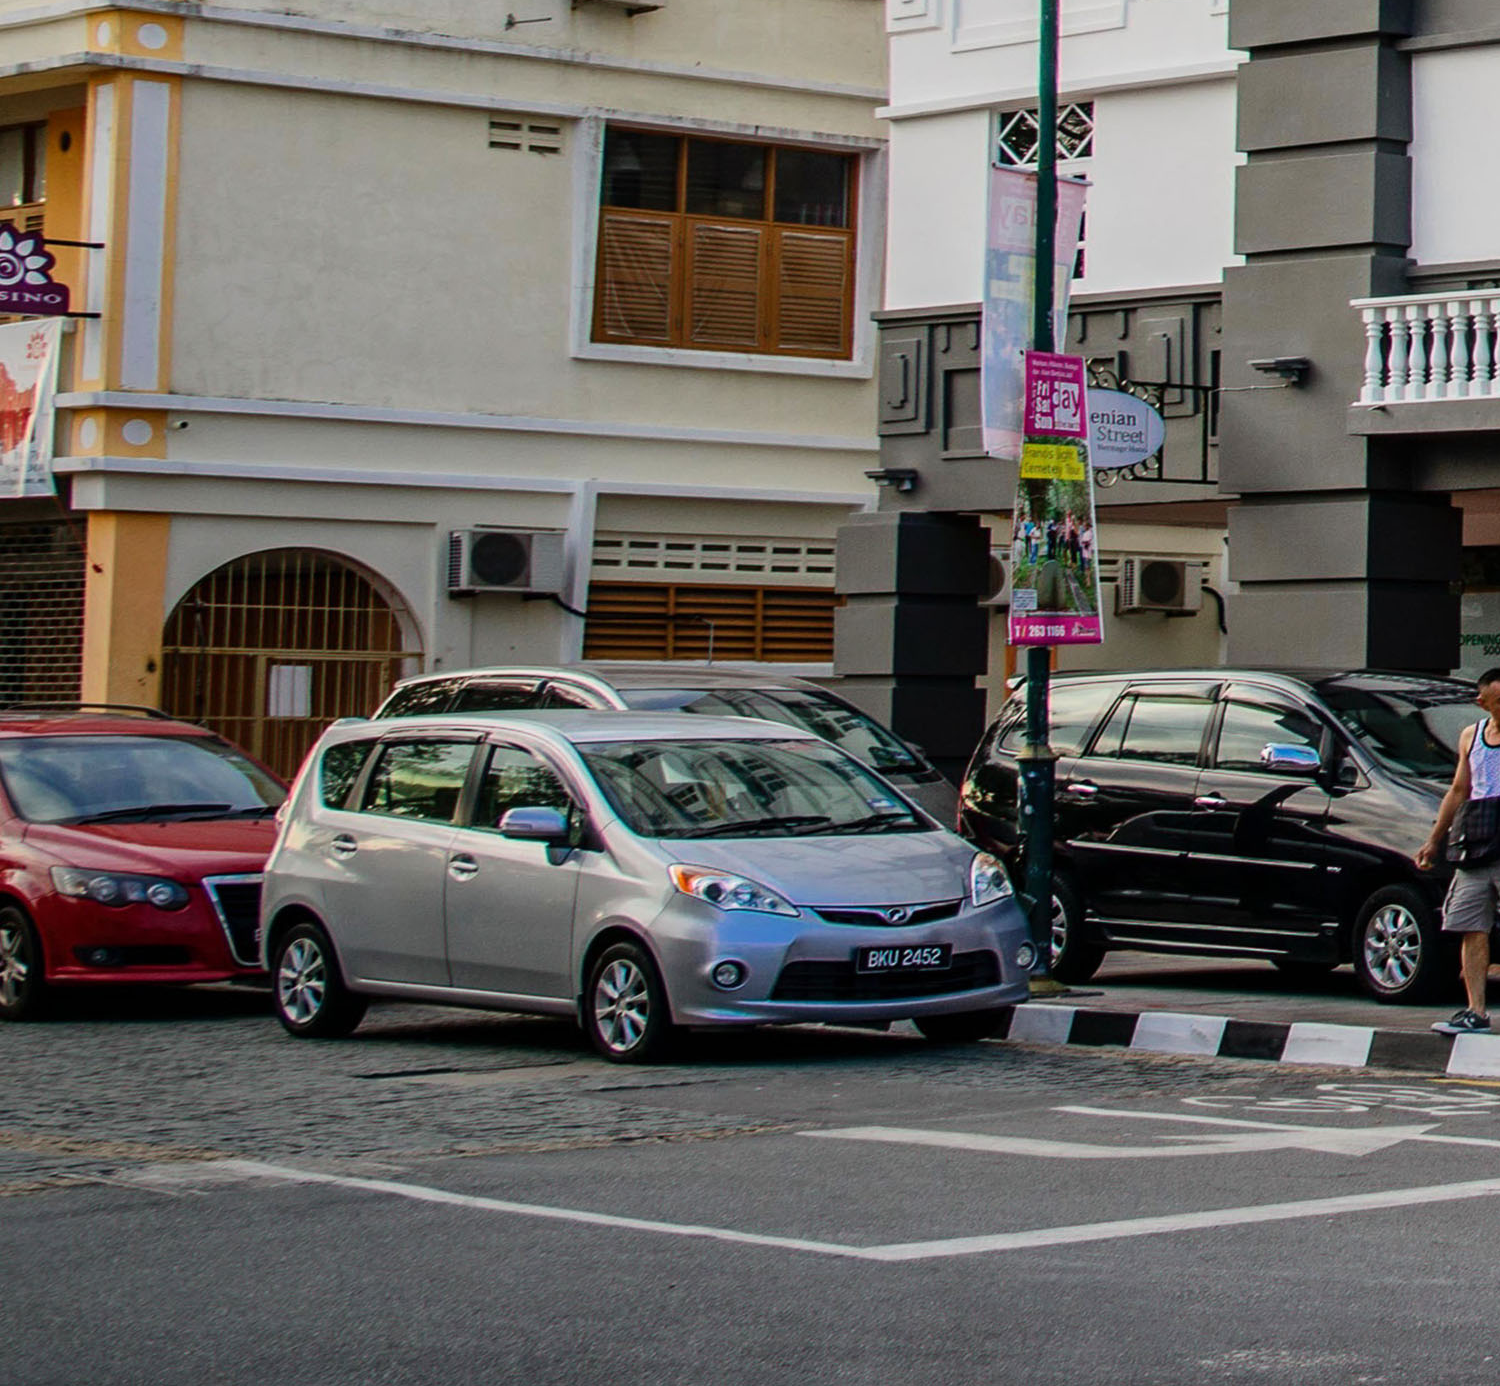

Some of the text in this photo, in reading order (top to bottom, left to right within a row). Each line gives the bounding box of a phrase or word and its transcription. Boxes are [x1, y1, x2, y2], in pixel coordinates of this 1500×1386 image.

[0, 291, 63, 304] SINO
[1036, 380, 1050, 396] Fri
[1036, 397, 1051, 413] Sat
[1034, 414, 1053, 430] Sun
[1090, 410, 1138, 427] enian
[1096, 426, 1145, 444] Street
[867, 947, 941, 968] BKU 2452
